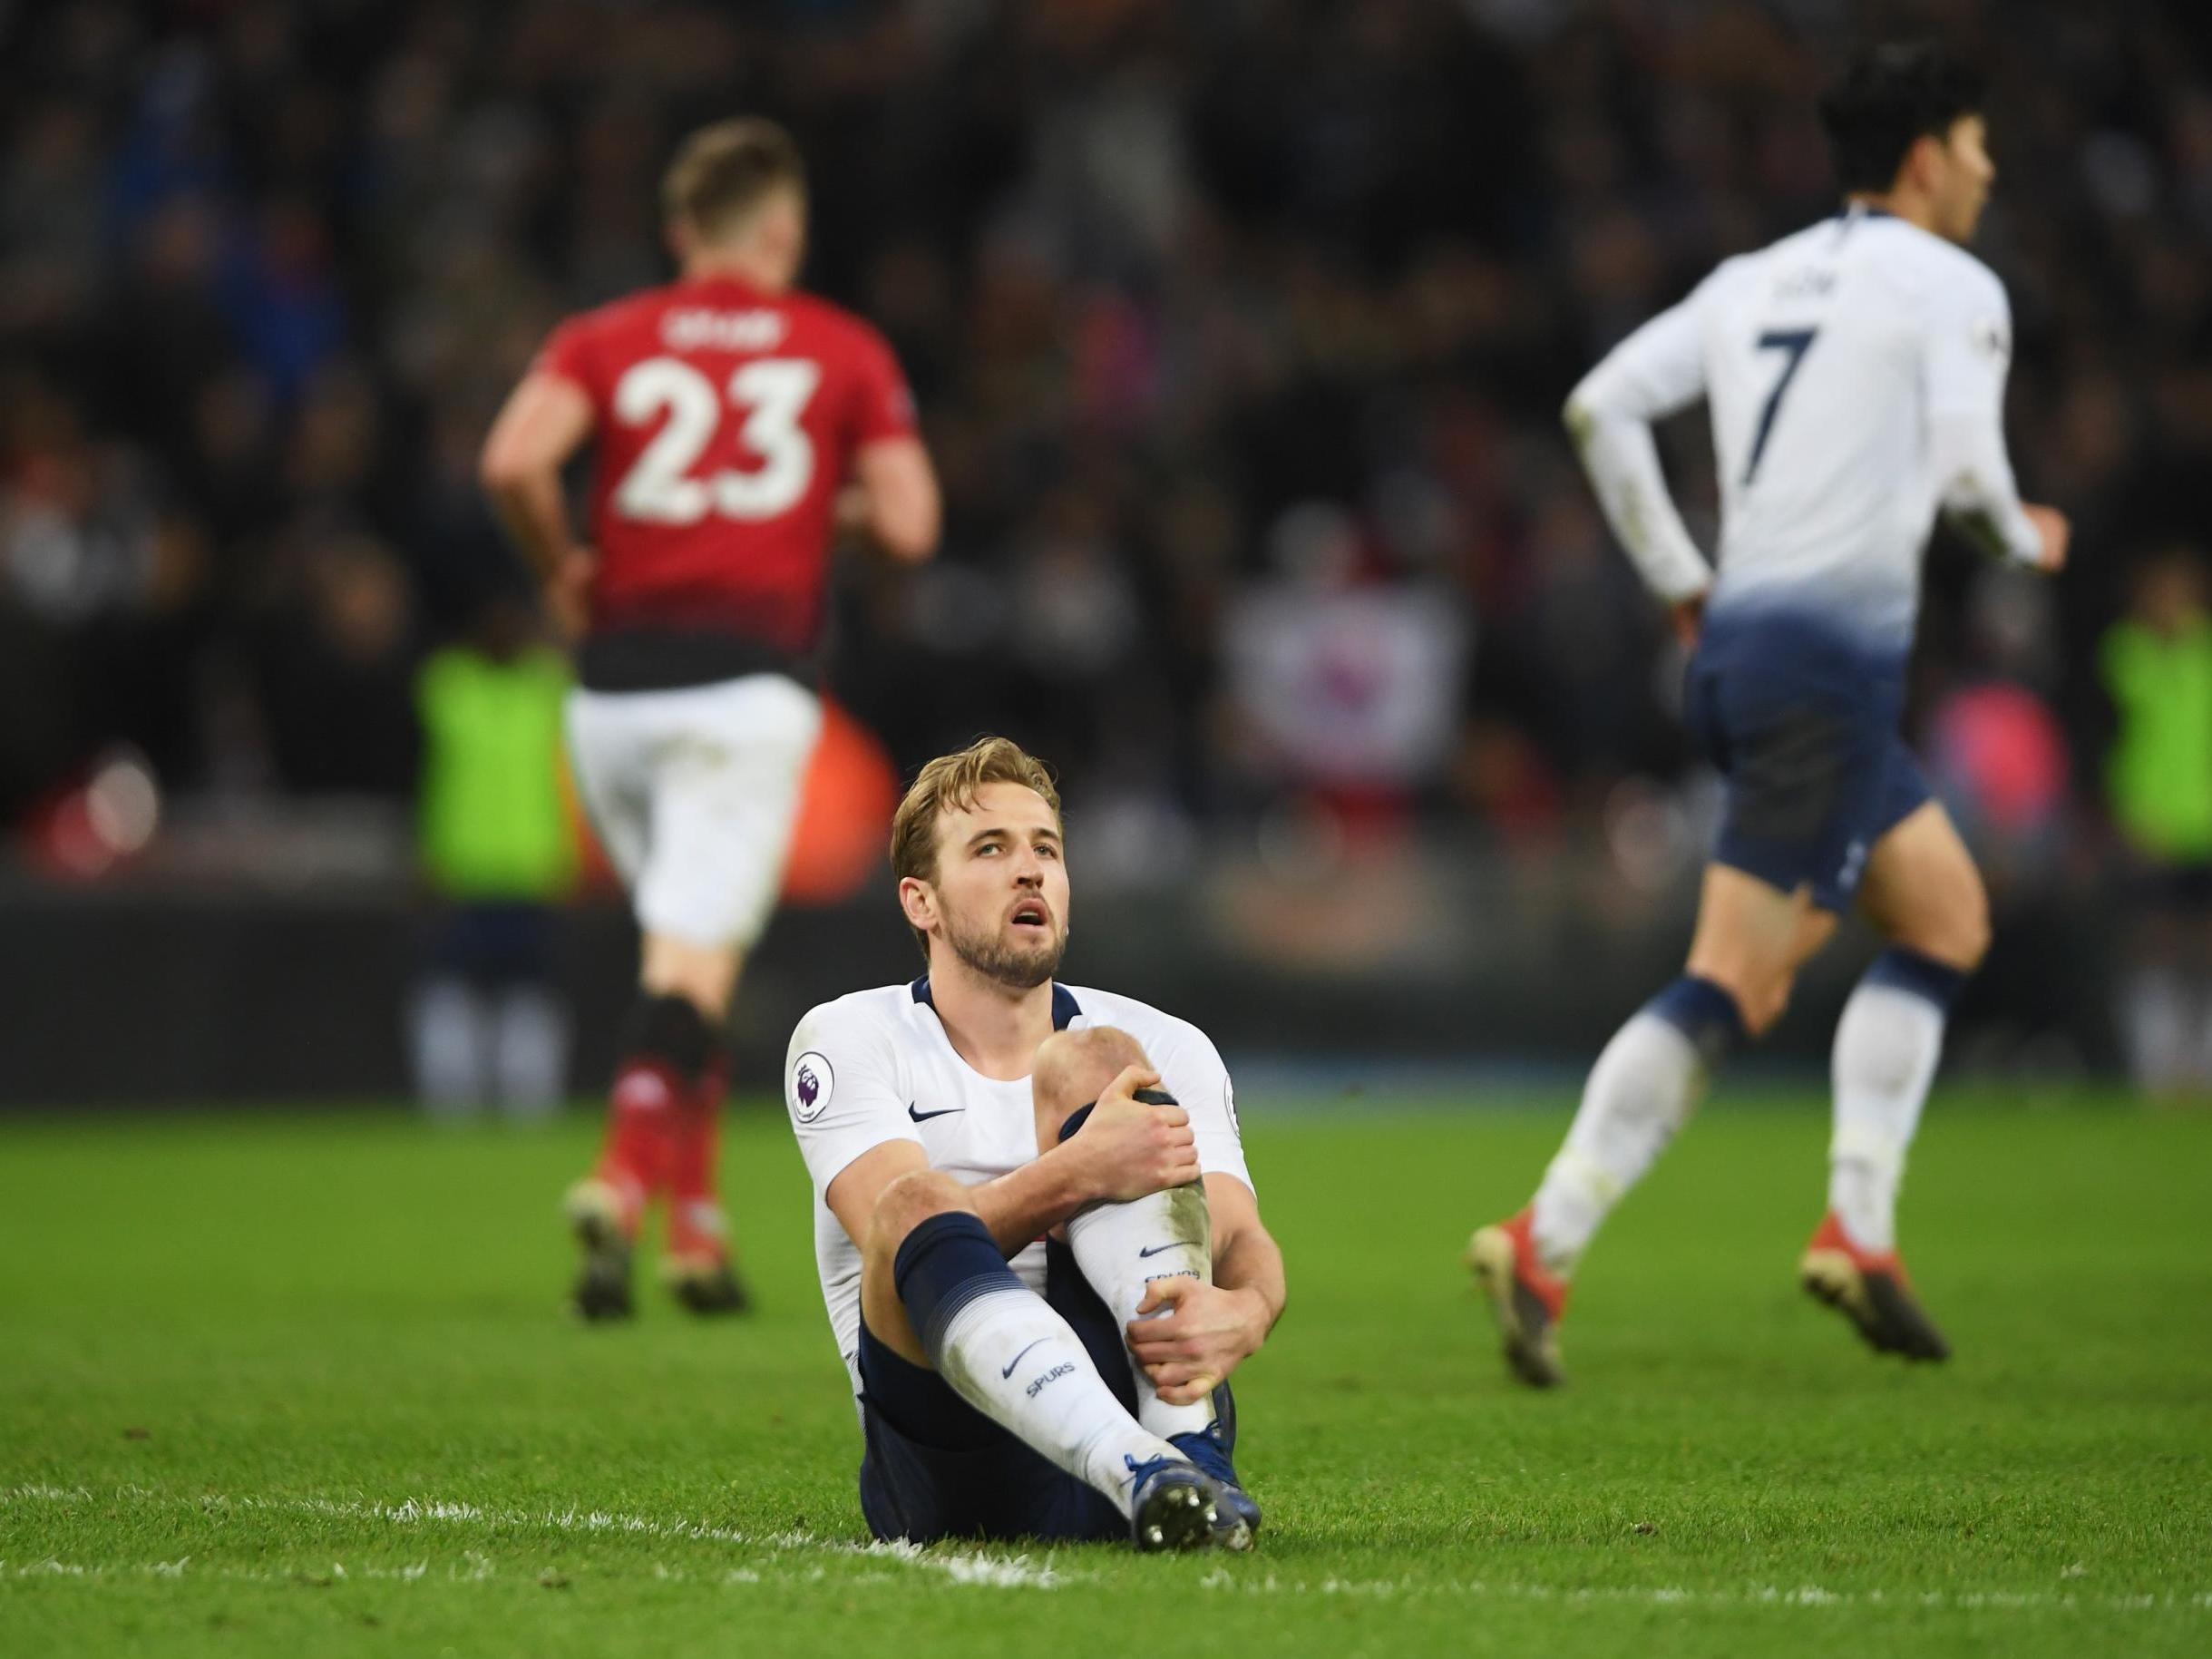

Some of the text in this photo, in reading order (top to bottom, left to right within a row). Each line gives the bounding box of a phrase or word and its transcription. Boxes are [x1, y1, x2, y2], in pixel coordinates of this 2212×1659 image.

[614, 357, 821, 524] 23
[1740, 327, 1821, 486] 7
[1026, 1361, 1076, 1398] SPURS
